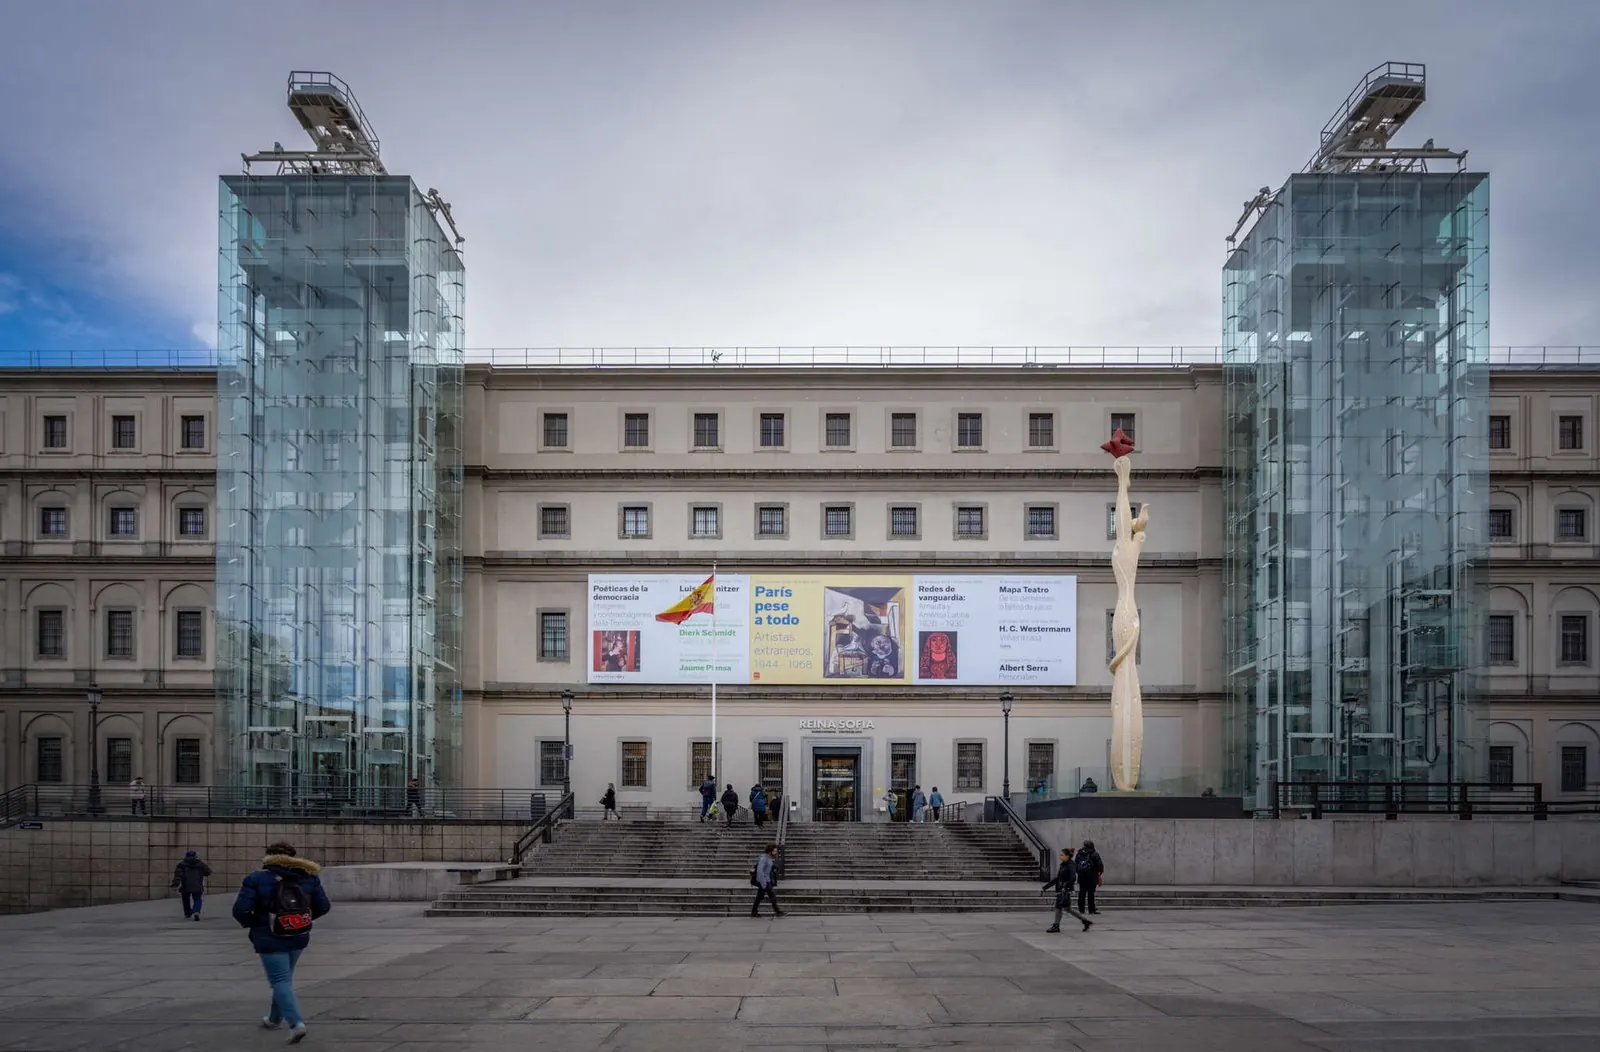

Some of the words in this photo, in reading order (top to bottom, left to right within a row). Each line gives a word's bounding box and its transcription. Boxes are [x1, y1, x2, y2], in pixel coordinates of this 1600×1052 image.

[755, 586, 792, 598] París
[755, 602, 789, 614] pese
[755, 616, 762, 624] a
[766, 614, 800, 624] todo
[754, 632, 796, 642] Artistas
[789, 660, 812, 669] 1968
[800, 720, 836, 729] REINA
